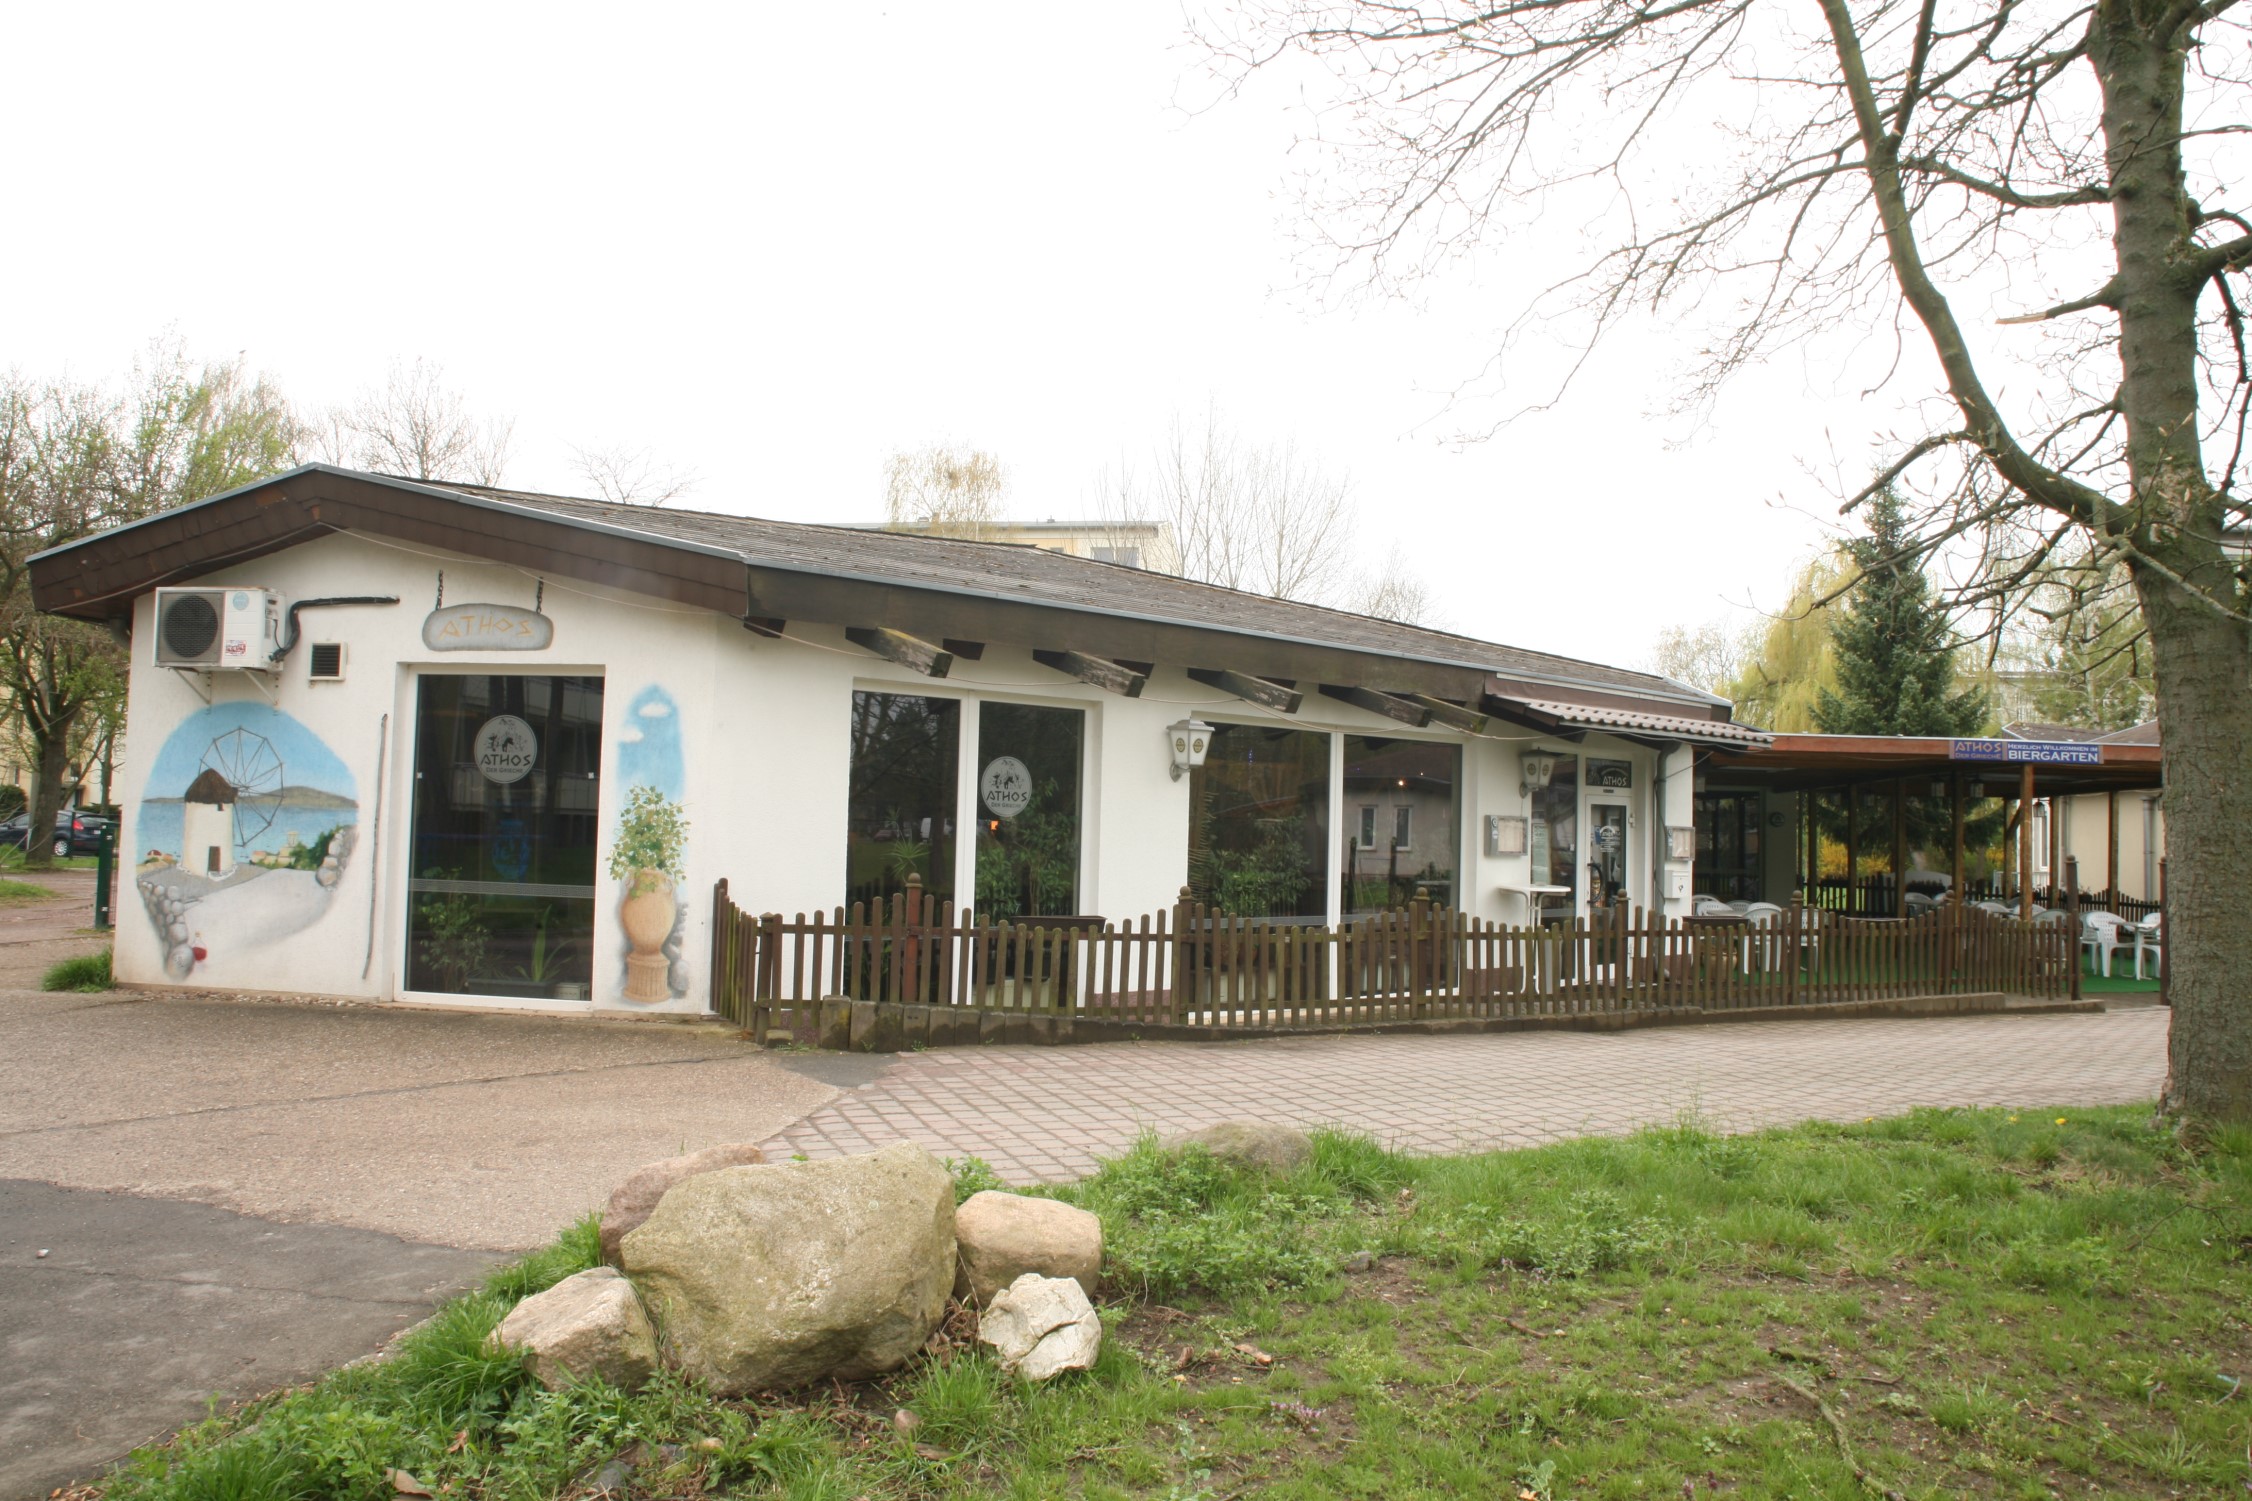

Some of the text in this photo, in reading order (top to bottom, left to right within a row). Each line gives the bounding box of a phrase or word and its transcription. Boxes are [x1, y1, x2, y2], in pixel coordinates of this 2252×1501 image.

[438, 614, 534, 639] ATHOS
[1955, 742, 2002, 753] ATHOS
[480, 754, 531, 767] ATHOS
[2008, 750, 2099, 762] BIERGARTEN
[1602, 776, 1627, 787] ATHOS
[986, 791, 1028, 802] ATHOS
